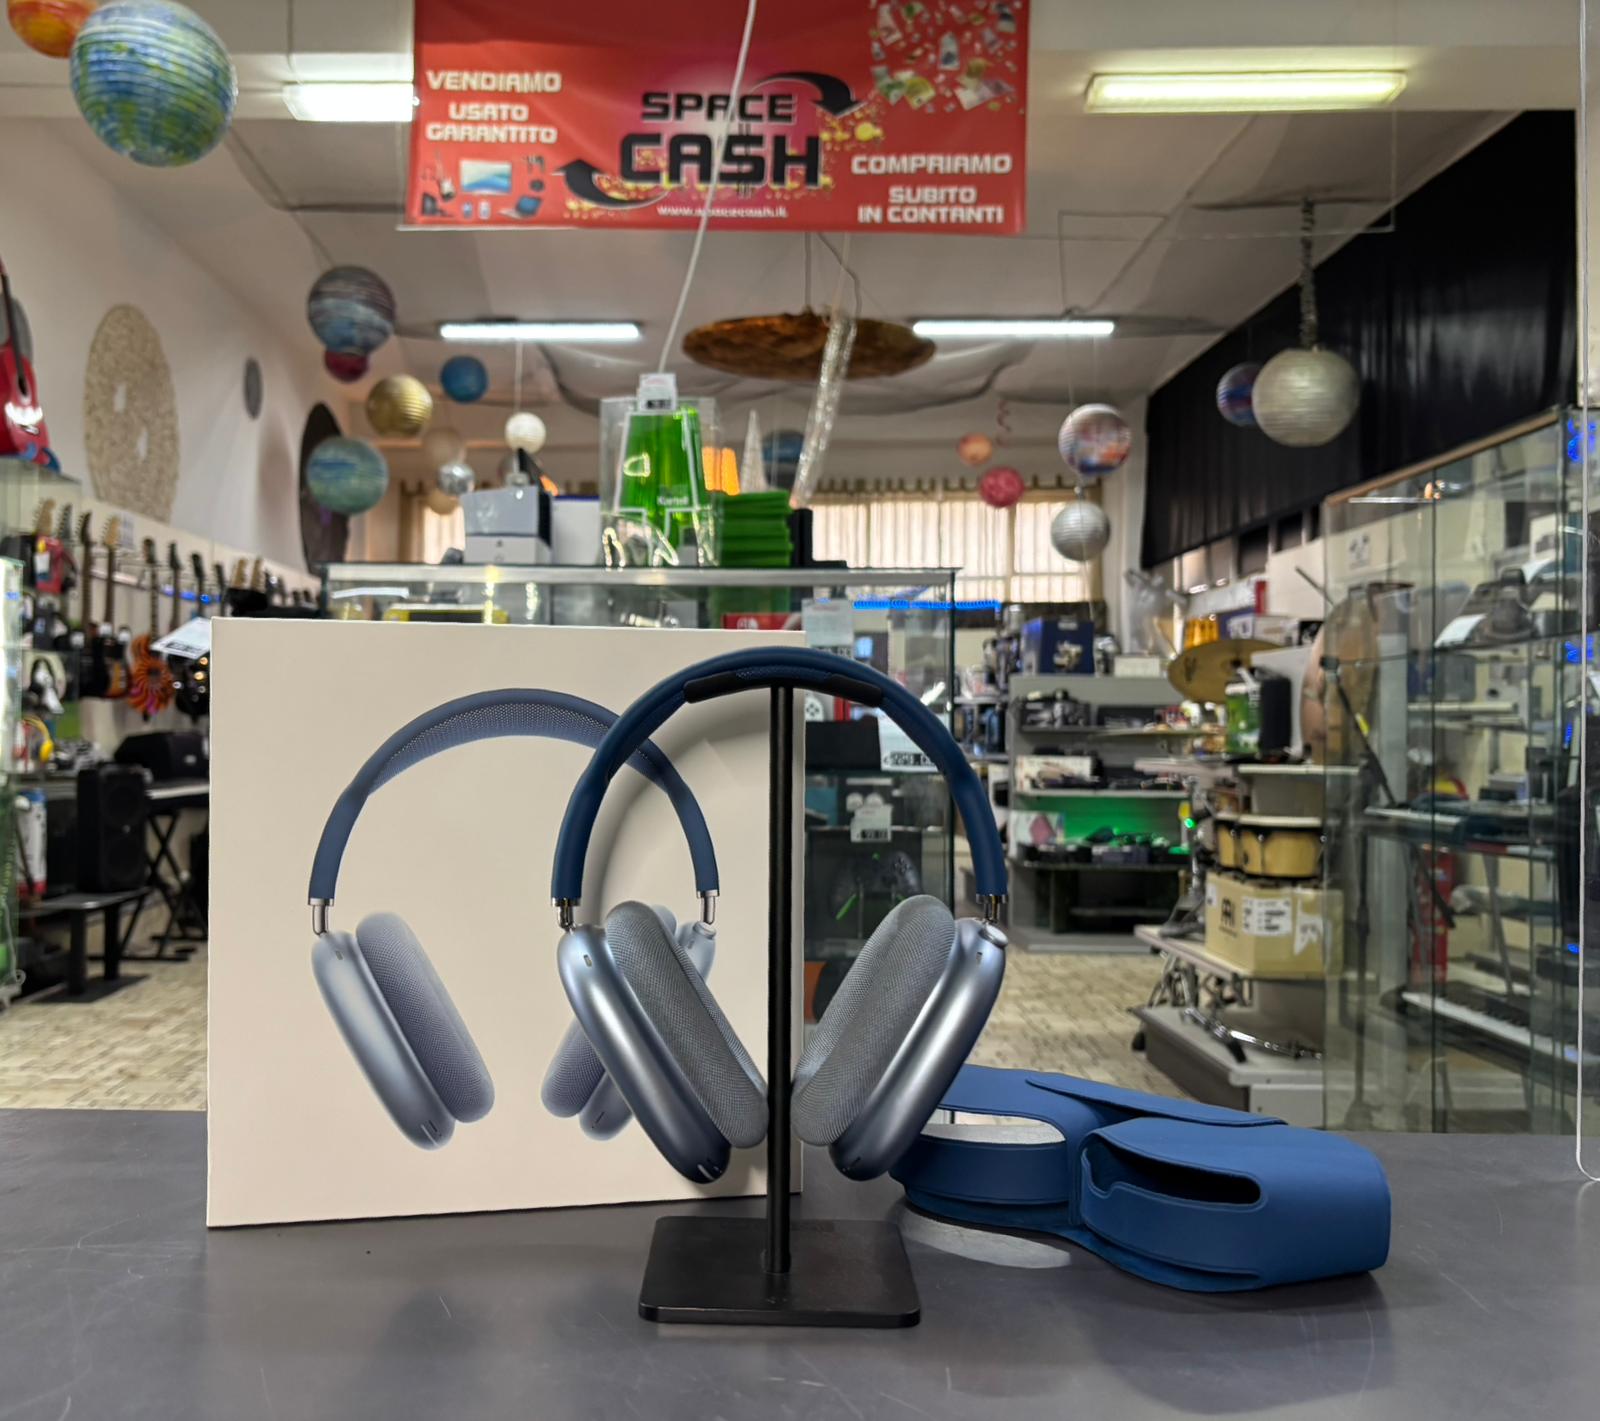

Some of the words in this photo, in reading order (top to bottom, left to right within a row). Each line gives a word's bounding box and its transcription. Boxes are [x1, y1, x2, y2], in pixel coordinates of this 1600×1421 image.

[426, 70, 562, 93] VENDIAMO
[448, 102, 529, 121] USATO
[642, 92, 795, 123] SPACE
[425, 122, 558, 144] GARANTITO
[621, 133, 821, 186] CASH
[851, 154, 1013, 175] COMPRIAMO
[888, 185, 978, 204] SUBITO
[857, 206, 883, 223] IN
[886, 206, 1005, 224] CONTANTI
